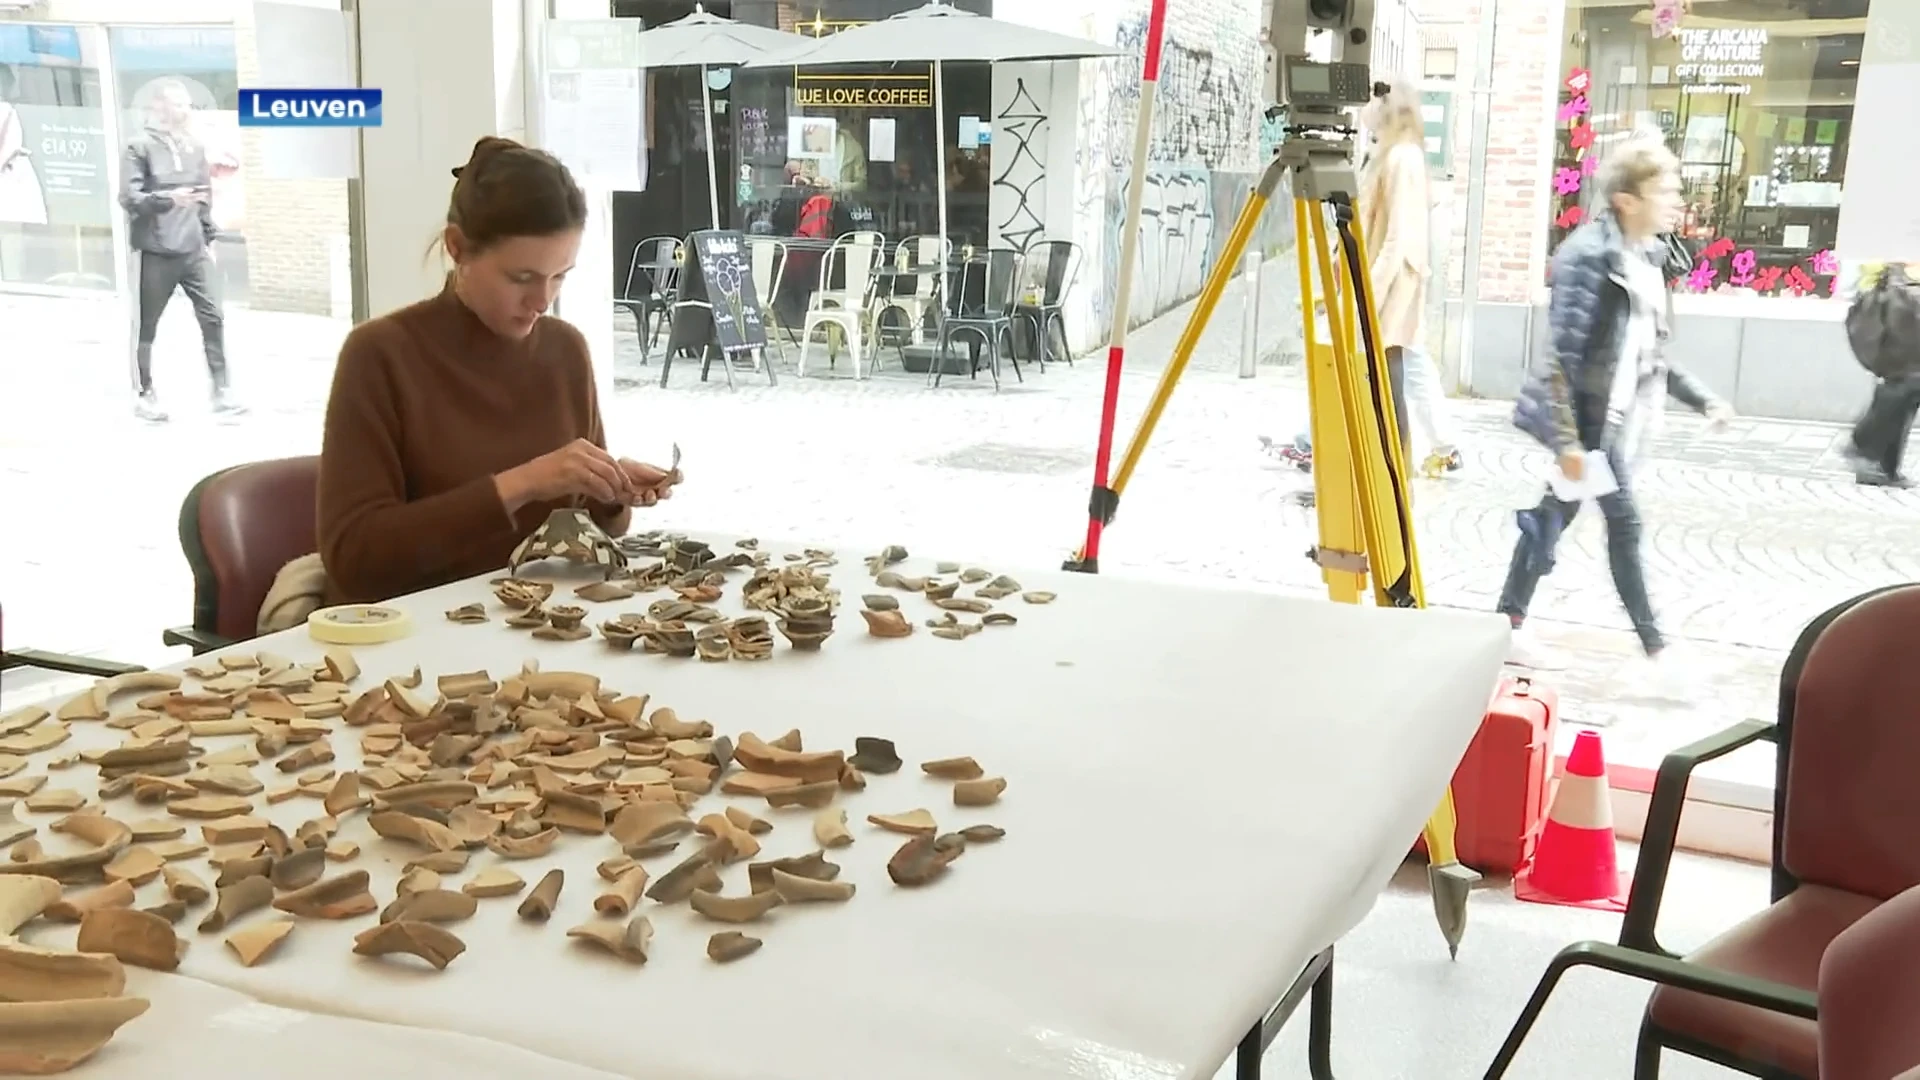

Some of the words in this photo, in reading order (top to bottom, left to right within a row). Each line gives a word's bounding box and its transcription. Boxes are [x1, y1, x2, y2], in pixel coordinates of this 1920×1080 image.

[1681, 29, 1708, 45] THE
[1709, 29, 1767, 45] ARCANA
[1682, 45, 1701, 61] OF
[1703, 45, 1762, 61] NATURE
[1675, 64, 1699, 77] GIFT
[1700, 64, 1764, 77] COLLECTION
[798, 89, 822, 103] WE
[826, 89, 865, 103] LOVE
[868, 89, 928, 103] COFFEE
